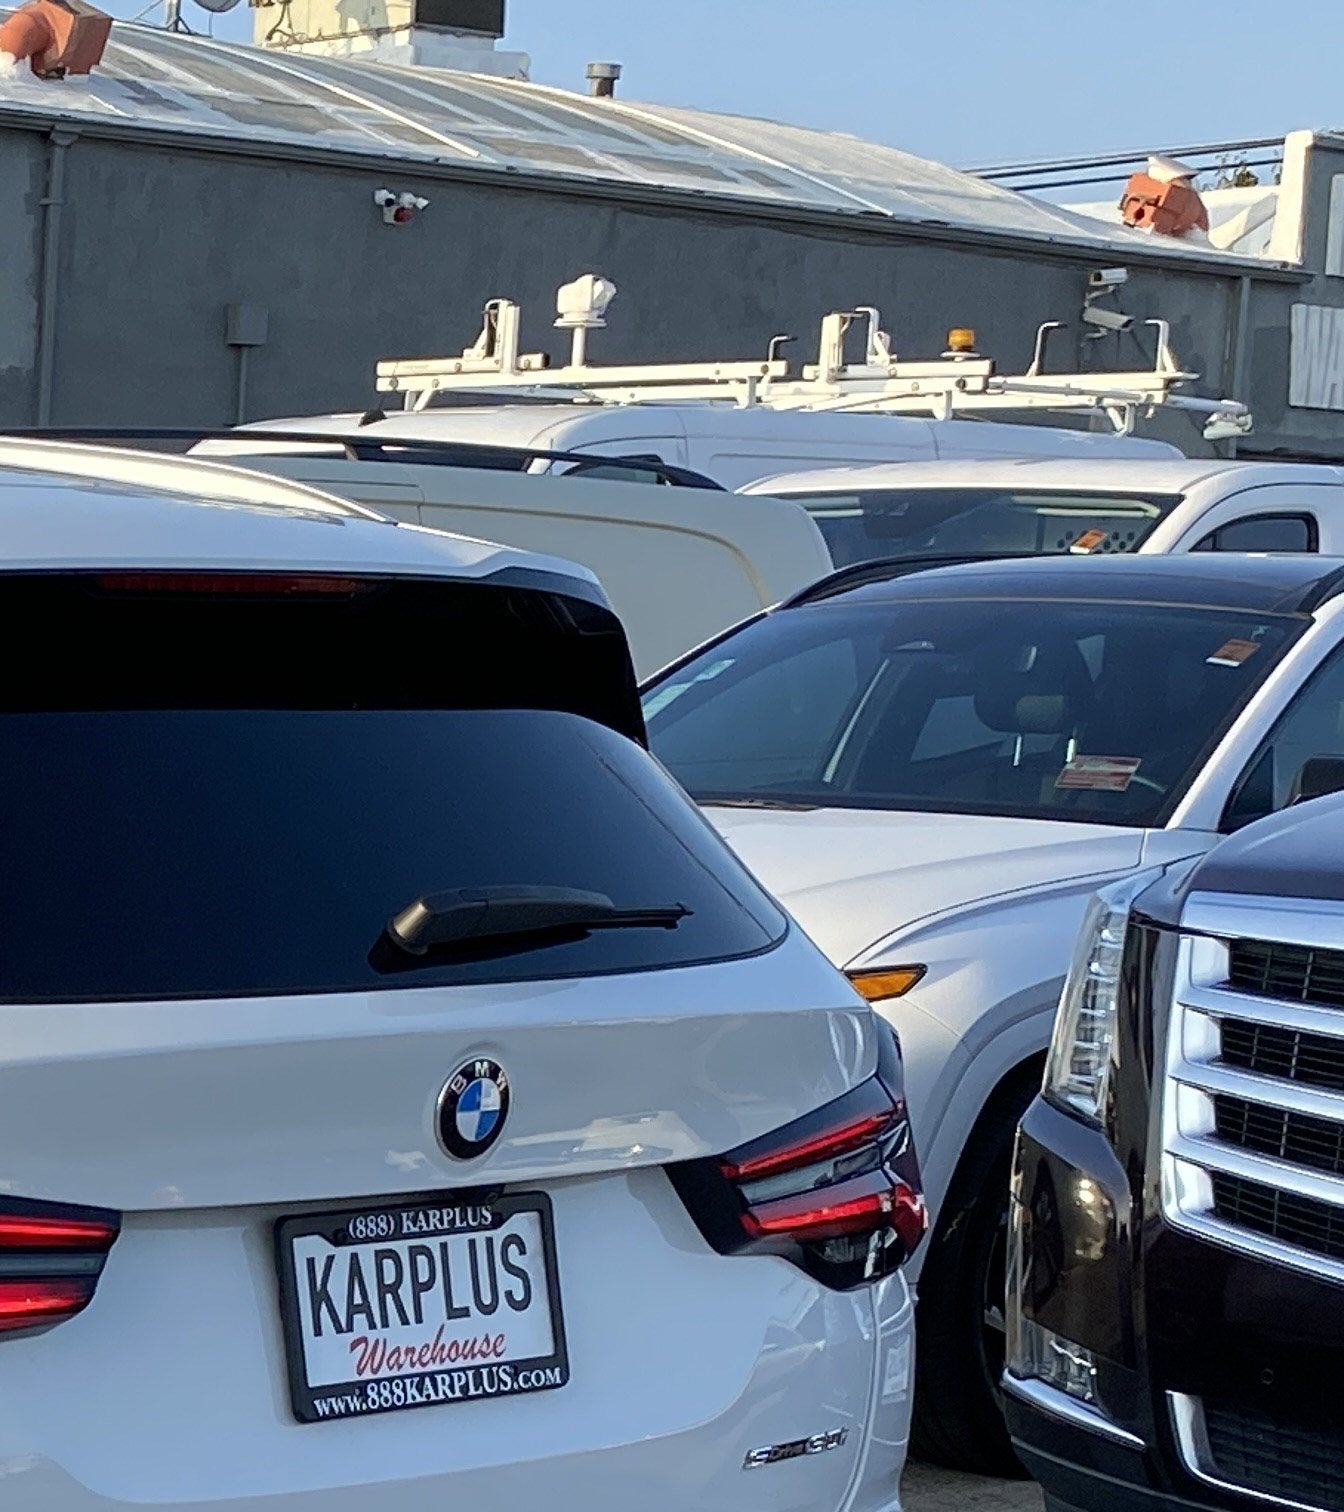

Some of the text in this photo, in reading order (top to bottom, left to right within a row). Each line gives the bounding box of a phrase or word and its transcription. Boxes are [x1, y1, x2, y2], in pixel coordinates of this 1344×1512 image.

[450, 1061, 508, 1095] BMW
[348, 1205, 493, 1239] (888) KARPLUS
[305, 1232, 533, 1338] KARPLUS
[349, 1322, 507, 1377] Warehouse
